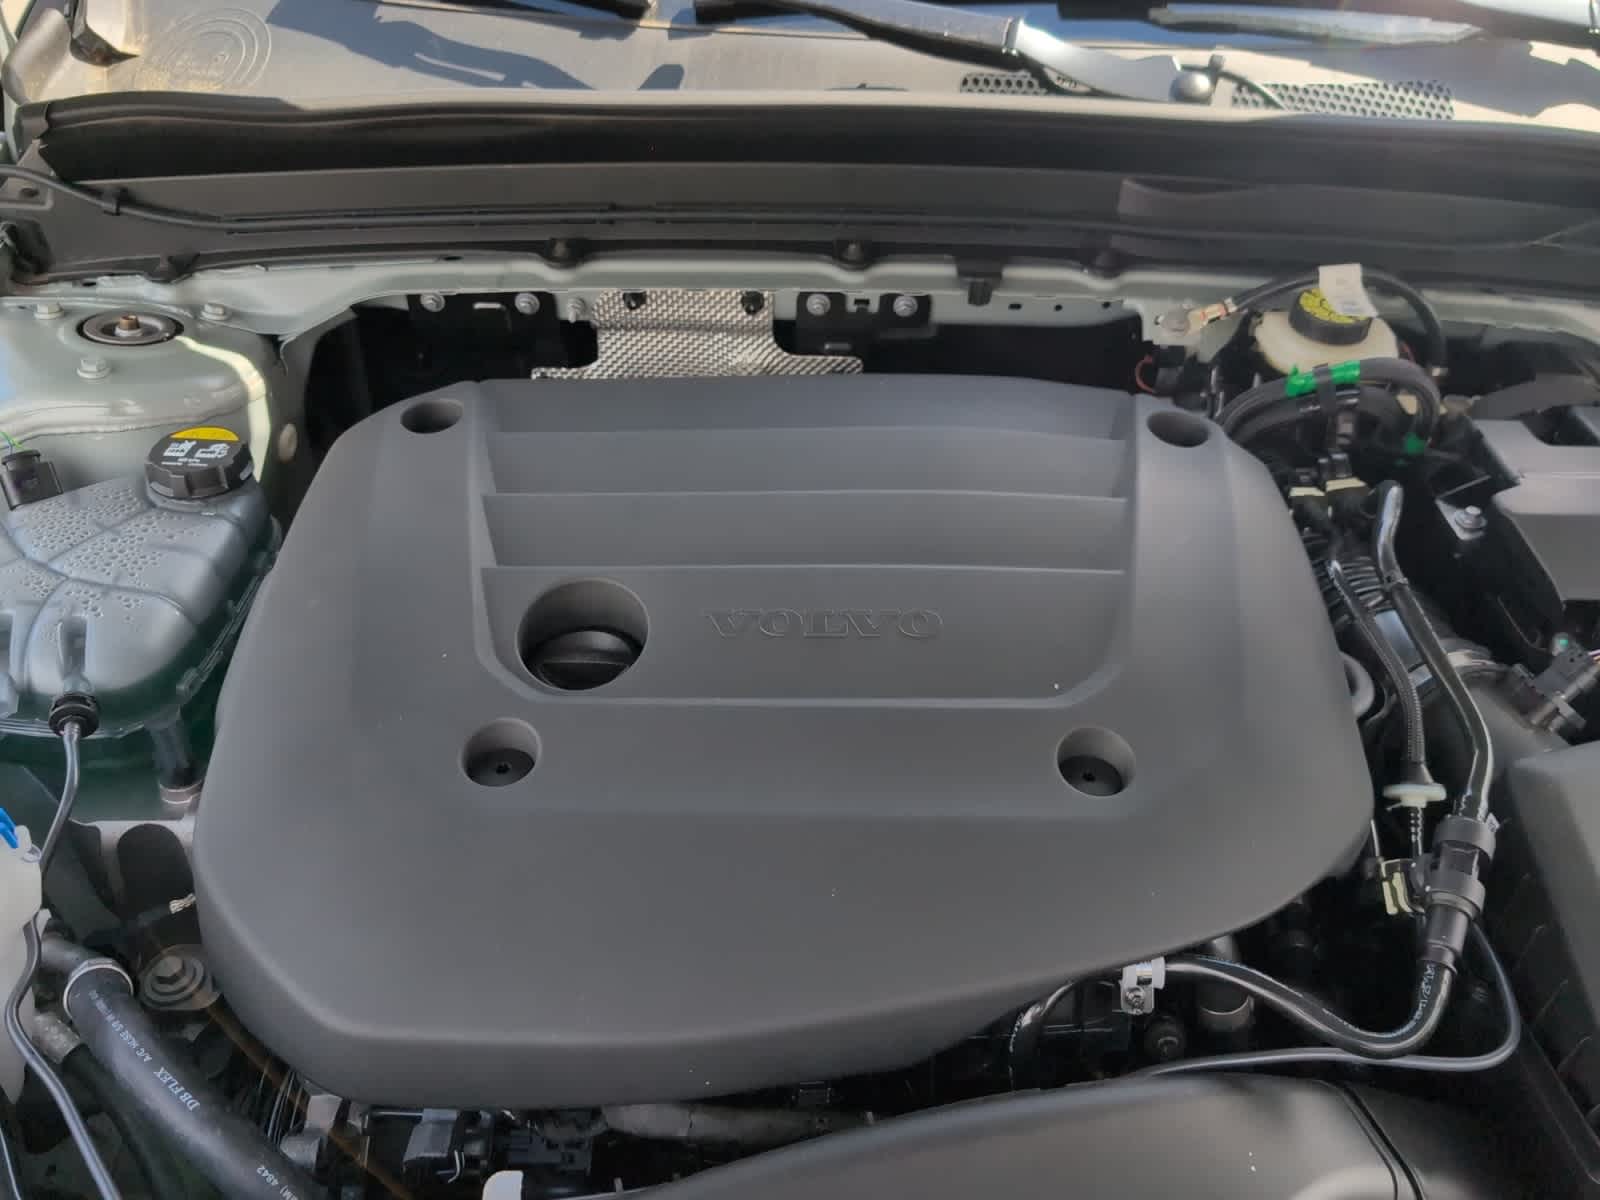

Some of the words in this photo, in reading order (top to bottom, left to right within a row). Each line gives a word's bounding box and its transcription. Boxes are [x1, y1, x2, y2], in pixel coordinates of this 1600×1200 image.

[704, 607, 945, 639] VOLVO
[153, 1067, 185, 1095] FLEX
[180, 1091, 201, 1112] DB
